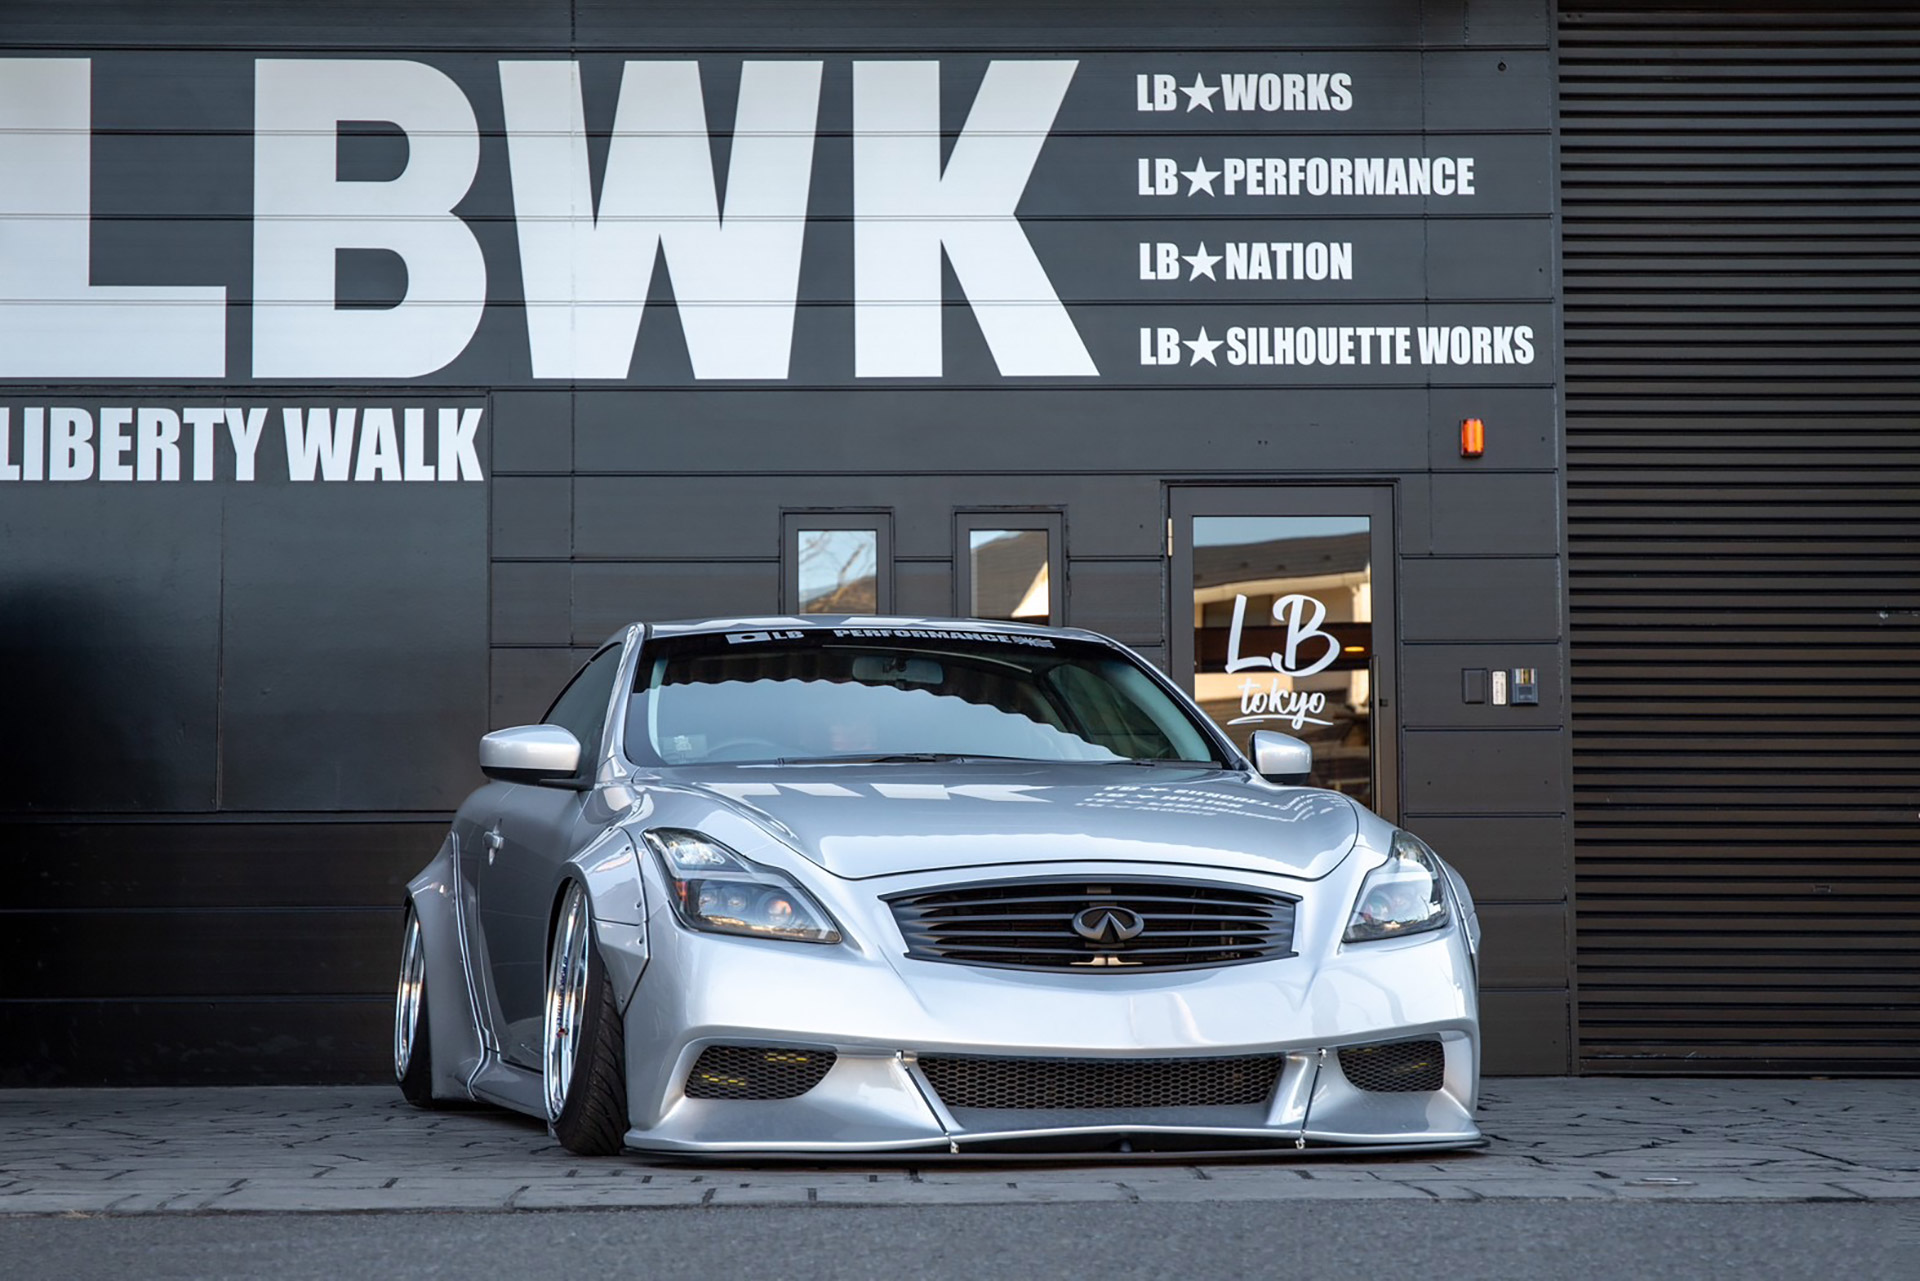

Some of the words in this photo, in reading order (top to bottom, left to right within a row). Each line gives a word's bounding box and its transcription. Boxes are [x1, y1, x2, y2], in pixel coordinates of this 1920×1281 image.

[0, 58, 1100, 380] LBWK
[1417, 325, 1535, 365] WORKS
[0, 407, 268, 481] LIBERTY
[283, 407, 484, 481] WALK
[772, 630, 805, 640] LB
[832, 629, 1014, 644] PERFORMANCE
[1225, 593, 1340, 677] LB
[1238, 677, 1327, 731] tokyo
